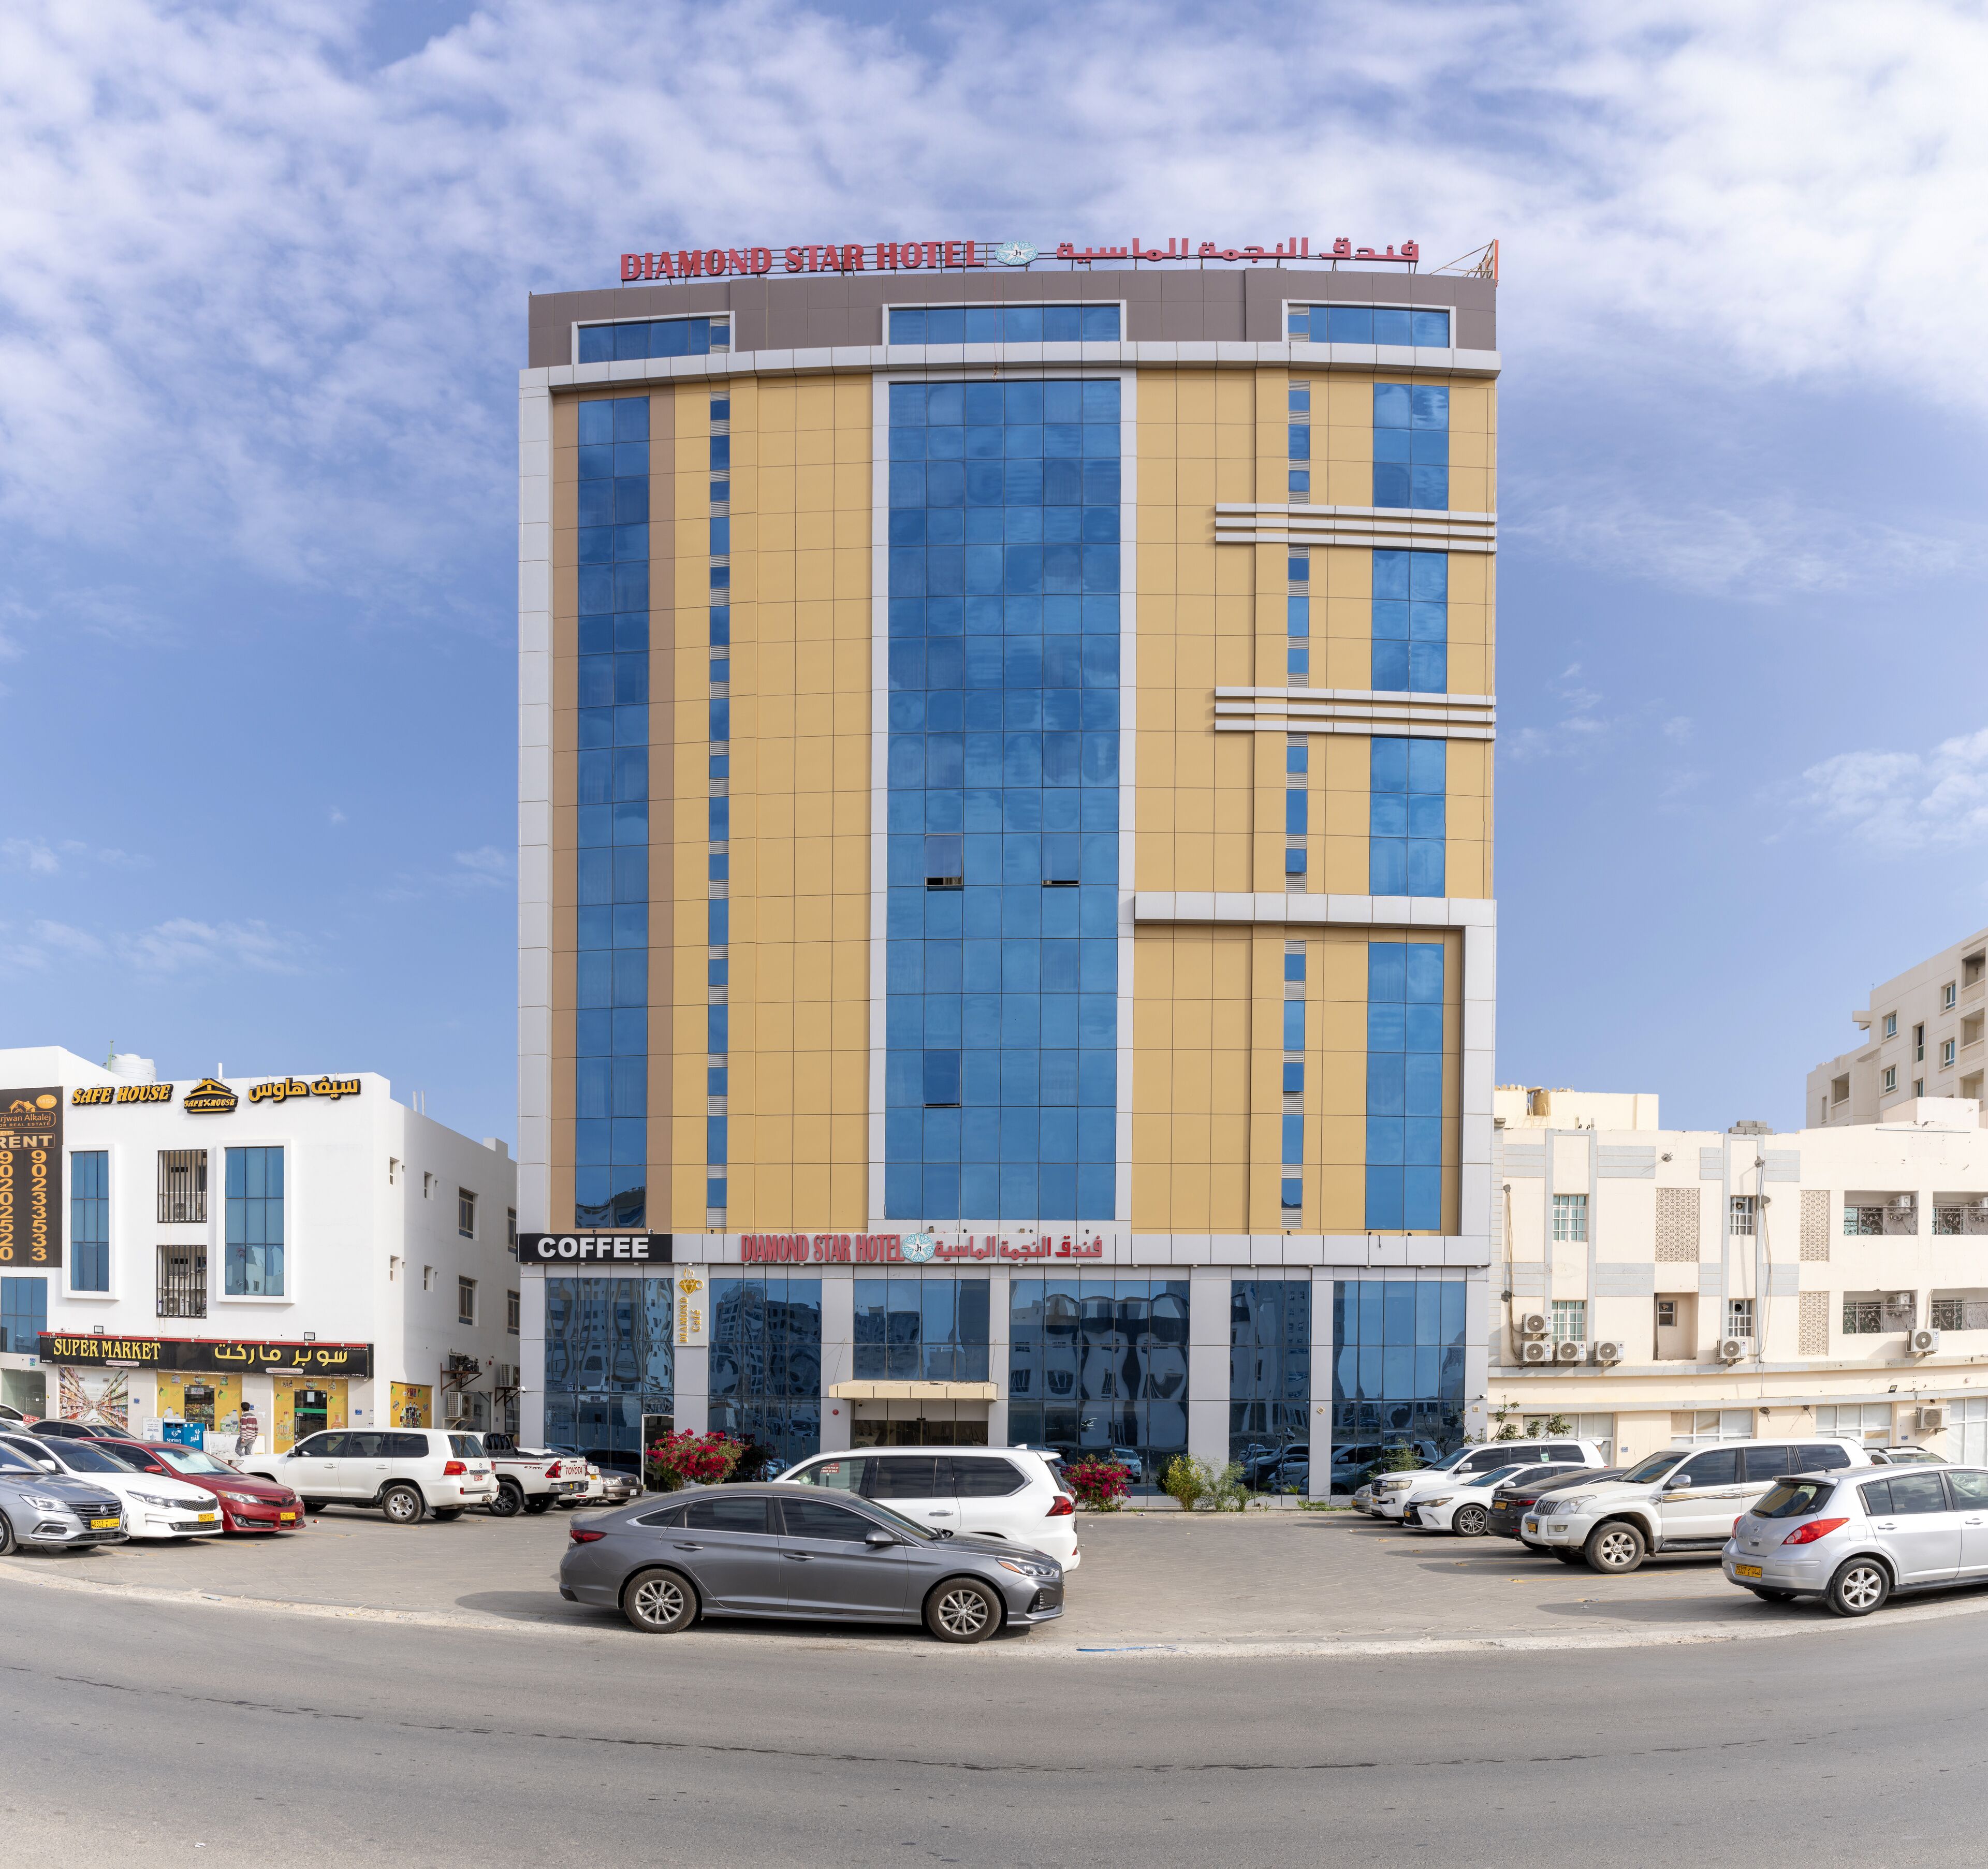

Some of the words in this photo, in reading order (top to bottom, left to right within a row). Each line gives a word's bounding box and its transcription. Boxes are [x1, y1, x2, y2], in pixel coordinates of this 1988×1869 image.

[621, 247, 772, 280] DIAMOND
[784, 244, 865, 272] STAR
[876, 240, 984, 268] HOTEL
[1057, 238, 1189, 264] الماسية
[1198, 237, 1309, 263] النجمة
[1319, 237, 1419, 262] فندق
[71, 1086, 113, 1105] SAFE
[116, 1084, 174, 1103] HOUSE
[248, 1078, 309, 1103] هاوس
[311, 1077, 361, 1099] سيف
[184, 1099, 203, 1107] SAFE
[0, 1115, 22, 1123] rjwan
[24, 1113, 51, 1122] Alkalej
[538, 1237, 649, 1258] COFFEE
[741, 1235, 809, 1262] DIAMOND
[813, 1234, 851, 1261] STAR
[856, 1234, 905, 1262] HOTEL
[935, 1235, 996, 1261] الماسية
[1000, 1236, 1051, 1261] النجمة
[1055, 1235, 1102, 1257] فندق
[679, 1297, 688, 1343] DIAMOND
[691, 1309, 701, 1333] Café
[54, 1338, 99, 1357] SUPER
[102, 1341, 161, 1360] MARKET
[215, 1344, 281, 1364] ماركت
[293, 1349, 347, 1367] سوبر
[1736, 1565, 1746, 1574] 75317
